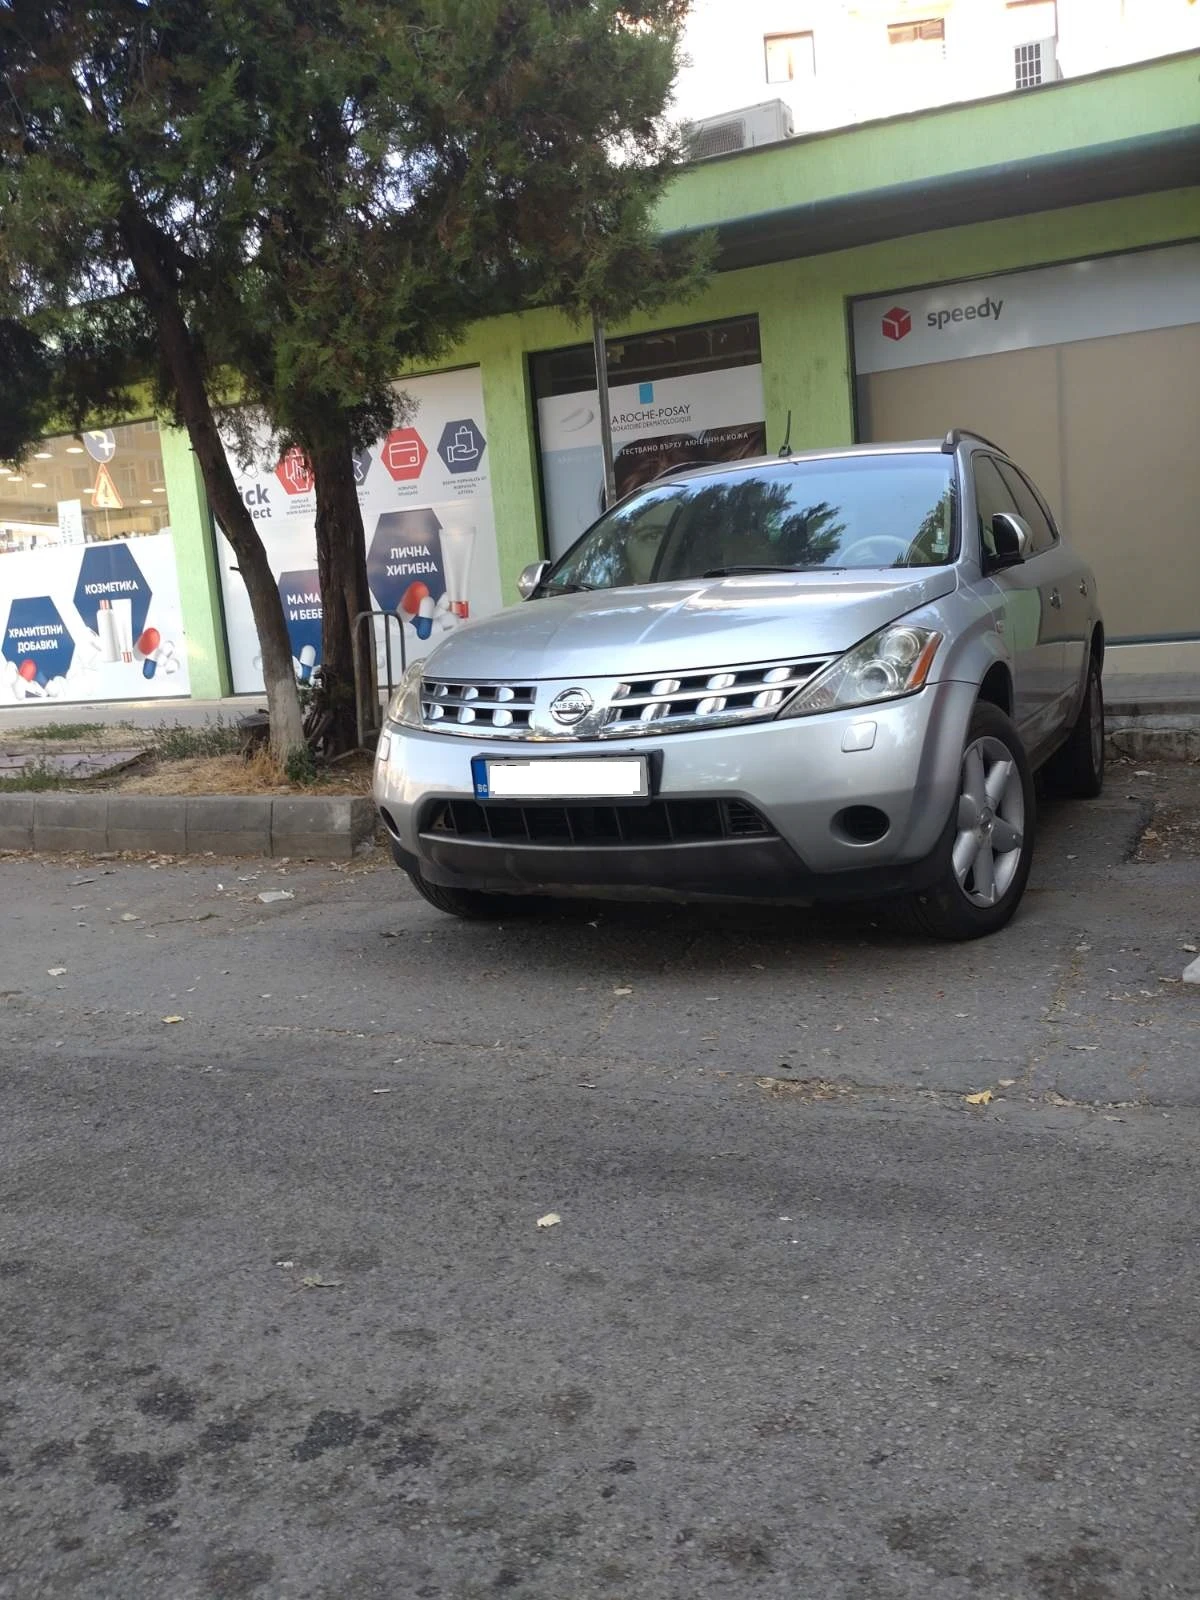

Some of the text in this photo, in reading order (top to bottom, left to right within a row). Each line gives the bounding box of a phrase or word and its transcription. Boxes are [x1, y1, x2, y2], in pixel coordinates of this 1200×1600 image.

[927, 297, 1003, 330] speedy
[610, 404, 691, 425] A ROCHE-POSAY
[610, 422, 641, 433] ABORATOIRE
[622, 444, 658, 456] ТЕСТВАНО
[659, 441, 682, 451] ВЪРХУ
[726, 431, 749, 441] КОЖА
[390, 545, 431, 559] ЛИЧНА
[386, 561, 438, 577] ХИГИЕНА
[84, 580, 139, 595] КОЗМЕТИКА
[287, 592, 322, 605] МАМА
[290, 608, 323, 621] И БЕБЕ
[8, 624, 63, 639] ХРАНИТЕЛНИ
[17, 639, 58, 654] ДОБАВКИ
[477, 783, 488, 793] BG
